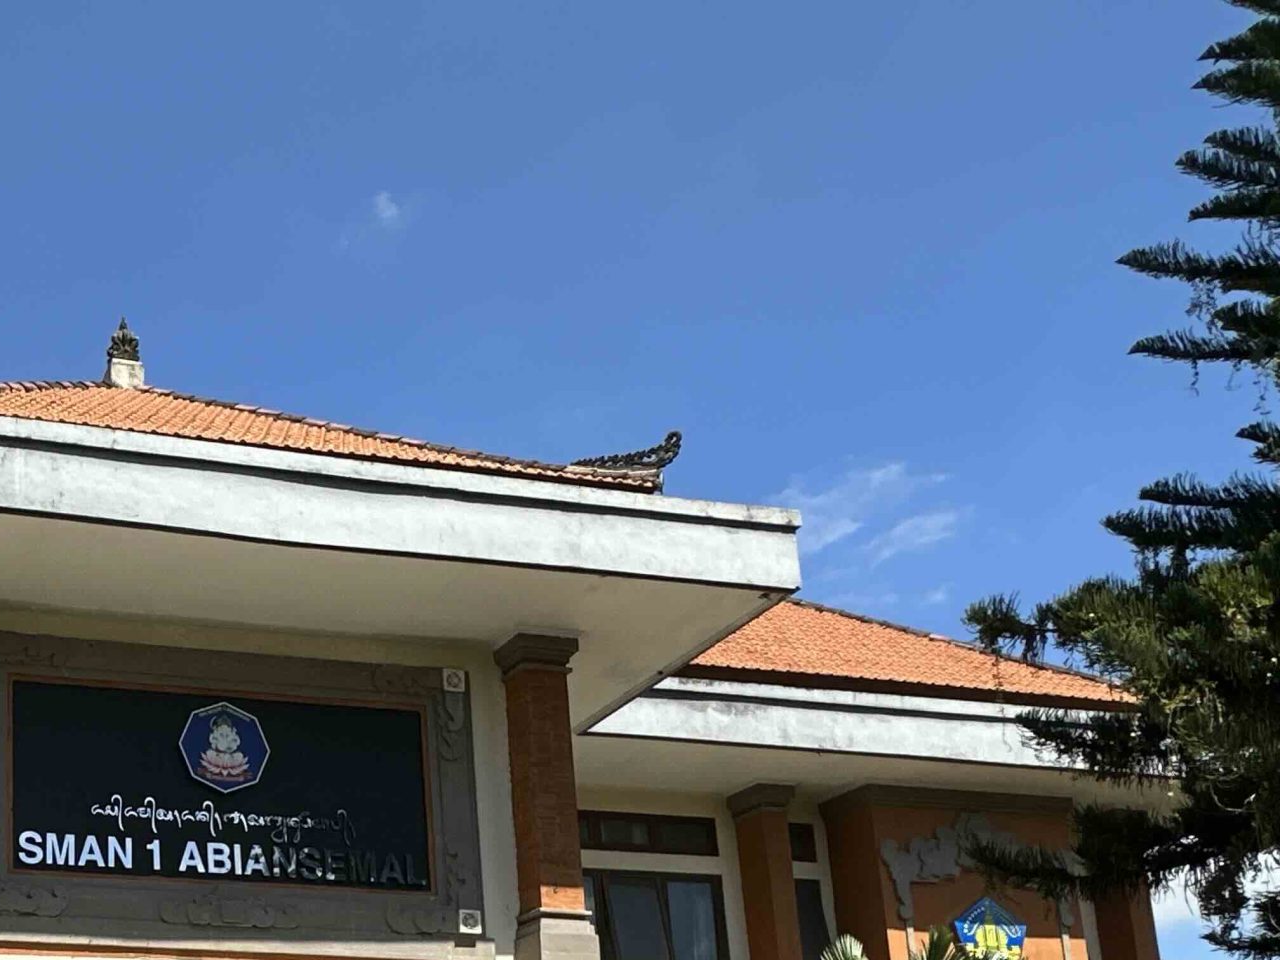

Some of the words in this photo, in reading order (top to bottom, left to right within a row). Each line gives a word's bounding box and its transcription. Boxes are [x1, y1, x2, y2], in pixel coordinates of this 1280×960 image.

[18, 831, 133, 869] SMAN
[146, 839, 162, 871] 1
[178, 840, 427, 887] ABIANSEMAL
